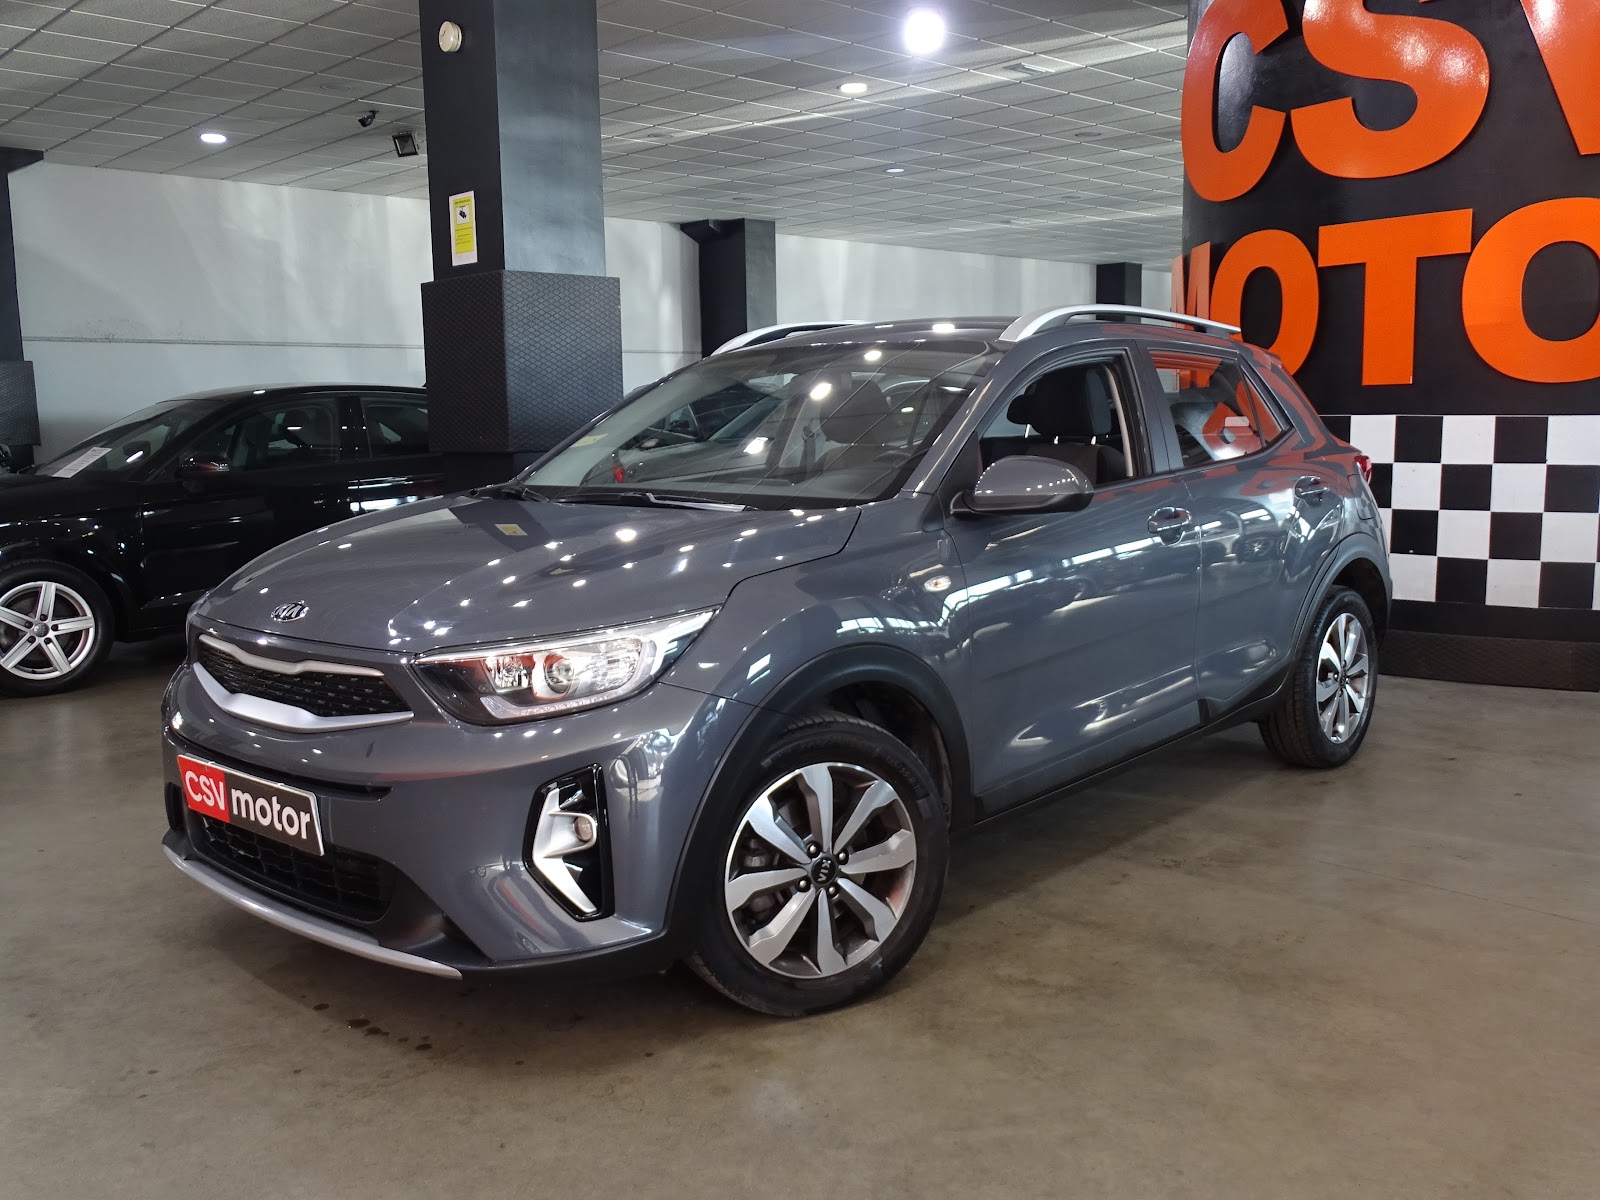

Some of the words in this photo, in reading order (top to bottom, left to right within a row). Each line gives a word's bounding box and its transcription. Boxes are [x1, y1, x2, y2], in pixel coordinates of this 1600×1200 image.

[273, 602, 303, 619] KIA
[185, 771, 226, 810] CSV
[231, 788, 311, 840] motor
[817, 859, 832, 882] KIA
